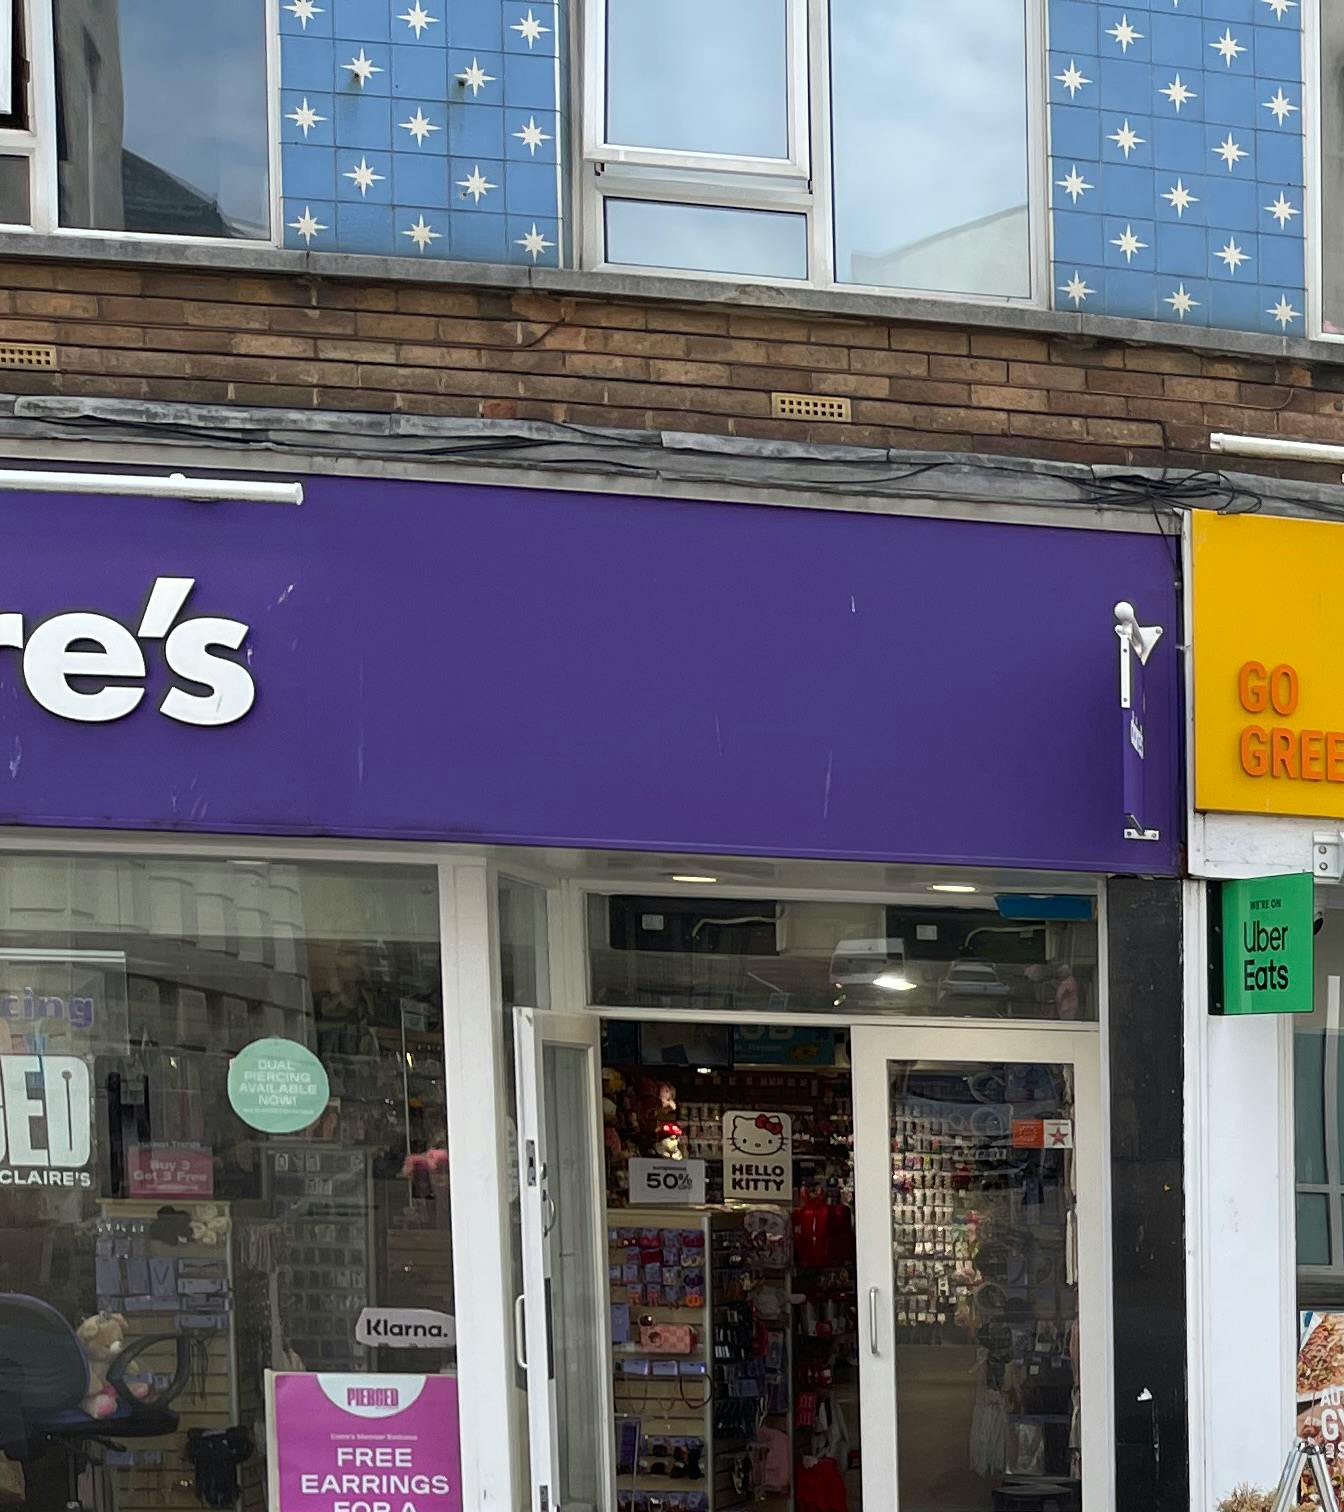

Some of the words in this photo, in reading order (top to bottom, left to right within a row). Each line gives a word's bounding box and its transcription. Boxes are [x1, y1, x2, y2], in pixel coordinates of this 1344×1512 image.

[1238, 660, 1299, 717] GO
[1243, 919, 1289, 954] Uber
[1243, 959, 1289, 992] Eats
[257, 1058, 297, 1072] DUAL
[243, 1070, 312, 1083] PIERCING
[238, 1082, 318, 1096] AVAILABLE
[258, 1094, 298, 1107] NOW!
[0, 1055, 91, 1168] ED
[0, 1168, 92, 1188] CLAIRE'S
[731, 1163, 785, 1177] HELLO
[646, 1172, 693, 1190] 50%
[731, 1178, 785, 1192] KITTY
[336, 1447, 413, 1468] FREE
[300, 1474, 450, 1495] EARRINGS
